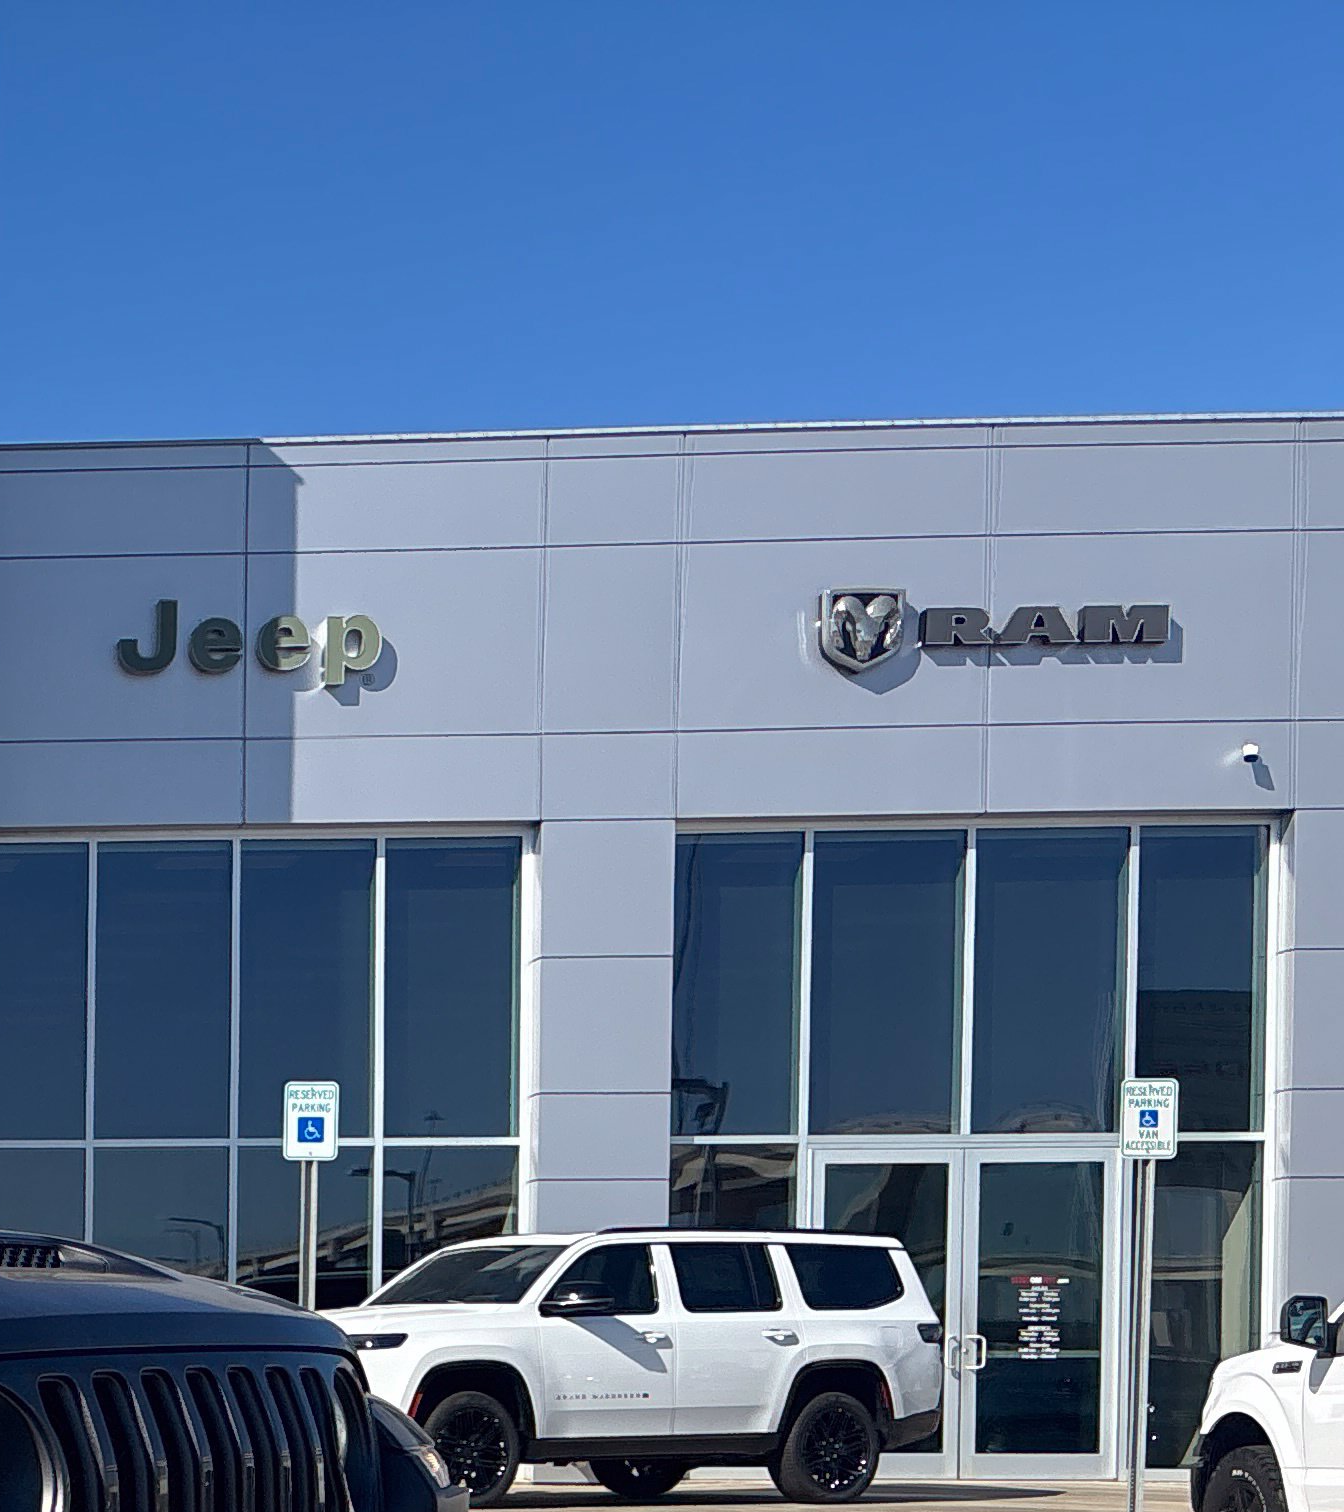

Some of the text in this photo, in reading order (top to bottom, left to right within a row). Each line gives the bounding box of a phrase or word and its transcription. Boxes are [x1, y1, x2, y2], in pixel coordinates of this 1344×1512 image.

[921, 604, 1171, 645] RAM
[116, 598, 382, 685] Jeep
[288, 1089, 335, 1100] RESERVED
[1125, 1086, 1173, 1096] RESERVED
[291, 1103, 332, 1113] PARKING
[1128, 1098, 1170, 1108] PARKING
[1138, 1130, 1159, 1139] VAN
[1125, 1140, 1171, 1151] ACCESSIBLE
